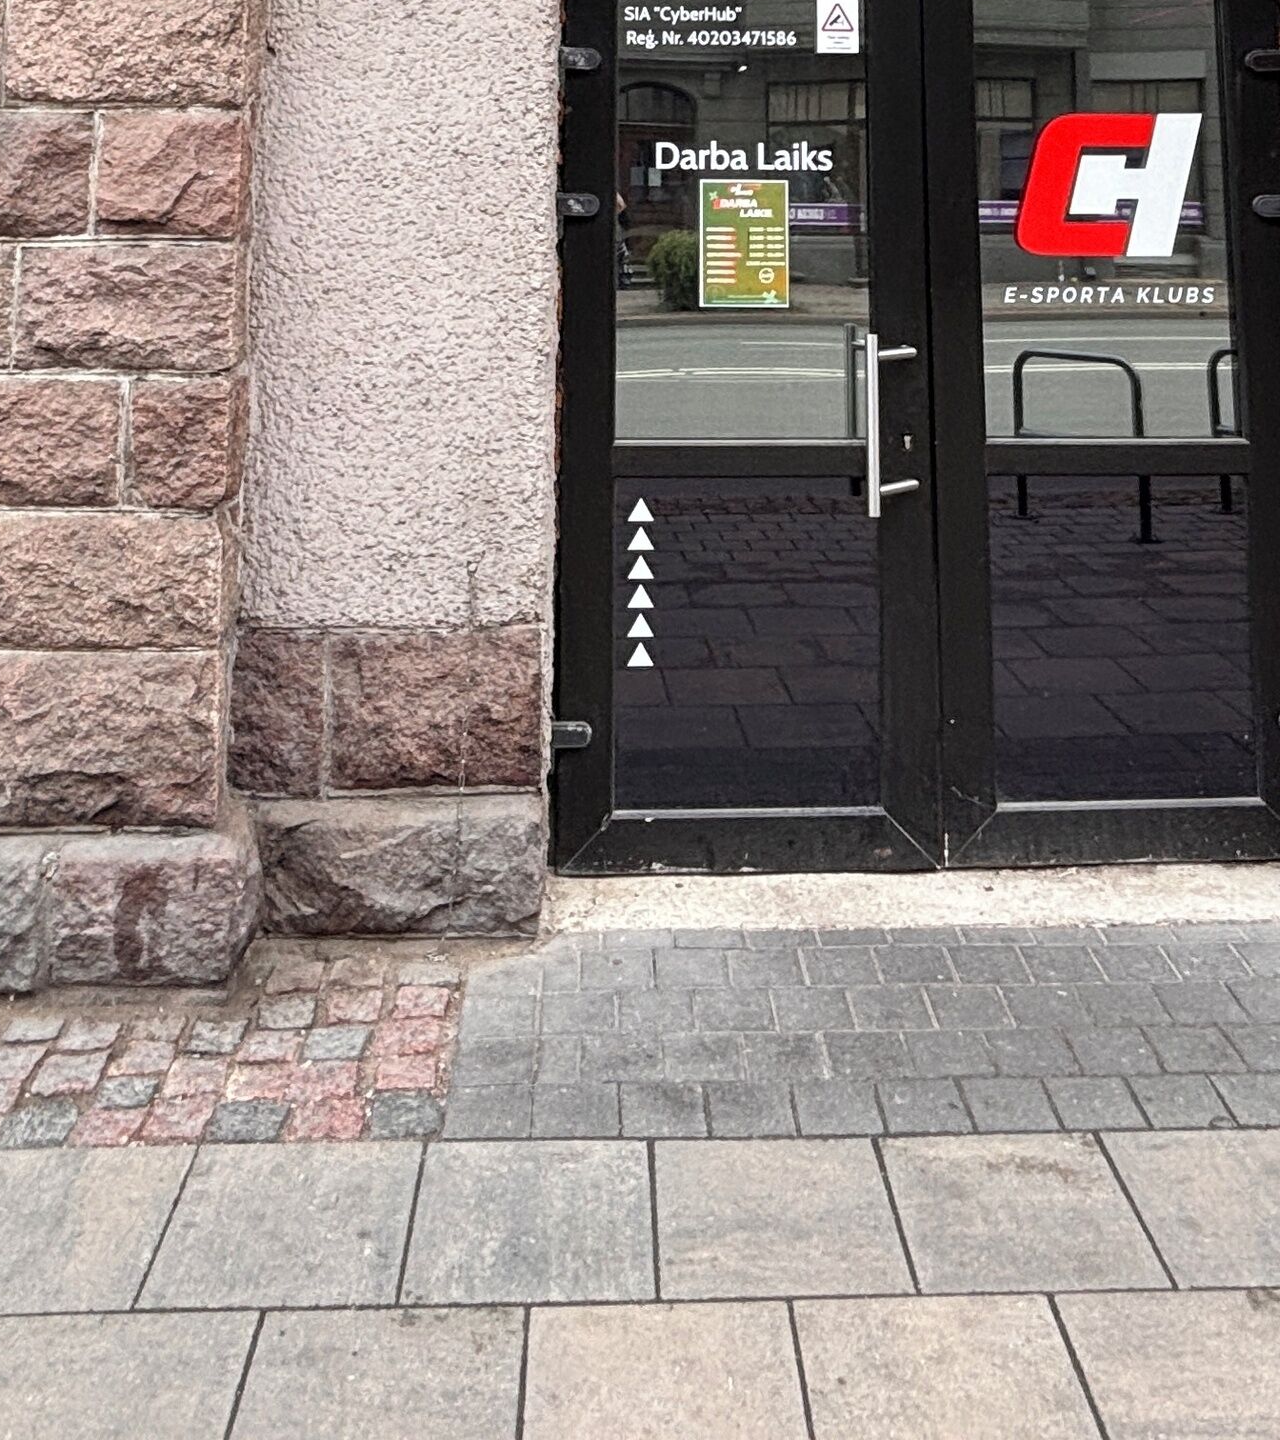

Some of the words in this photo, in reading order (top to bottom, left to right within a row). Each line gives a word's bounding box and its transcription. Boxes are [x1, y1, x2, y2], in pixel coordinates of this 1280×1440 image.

[624, 6, 651, 21] SIA
[661, 30, 684, 46] Nr.
[686, 30, 797, 46] 40203471586
[655, 140, 749, 171] Darba
[757, 141, 833, 172] Laiks
[1003, 286, 1125, 304] E-SPORTA
[1135, 286, 1215, 304] KLUBS
